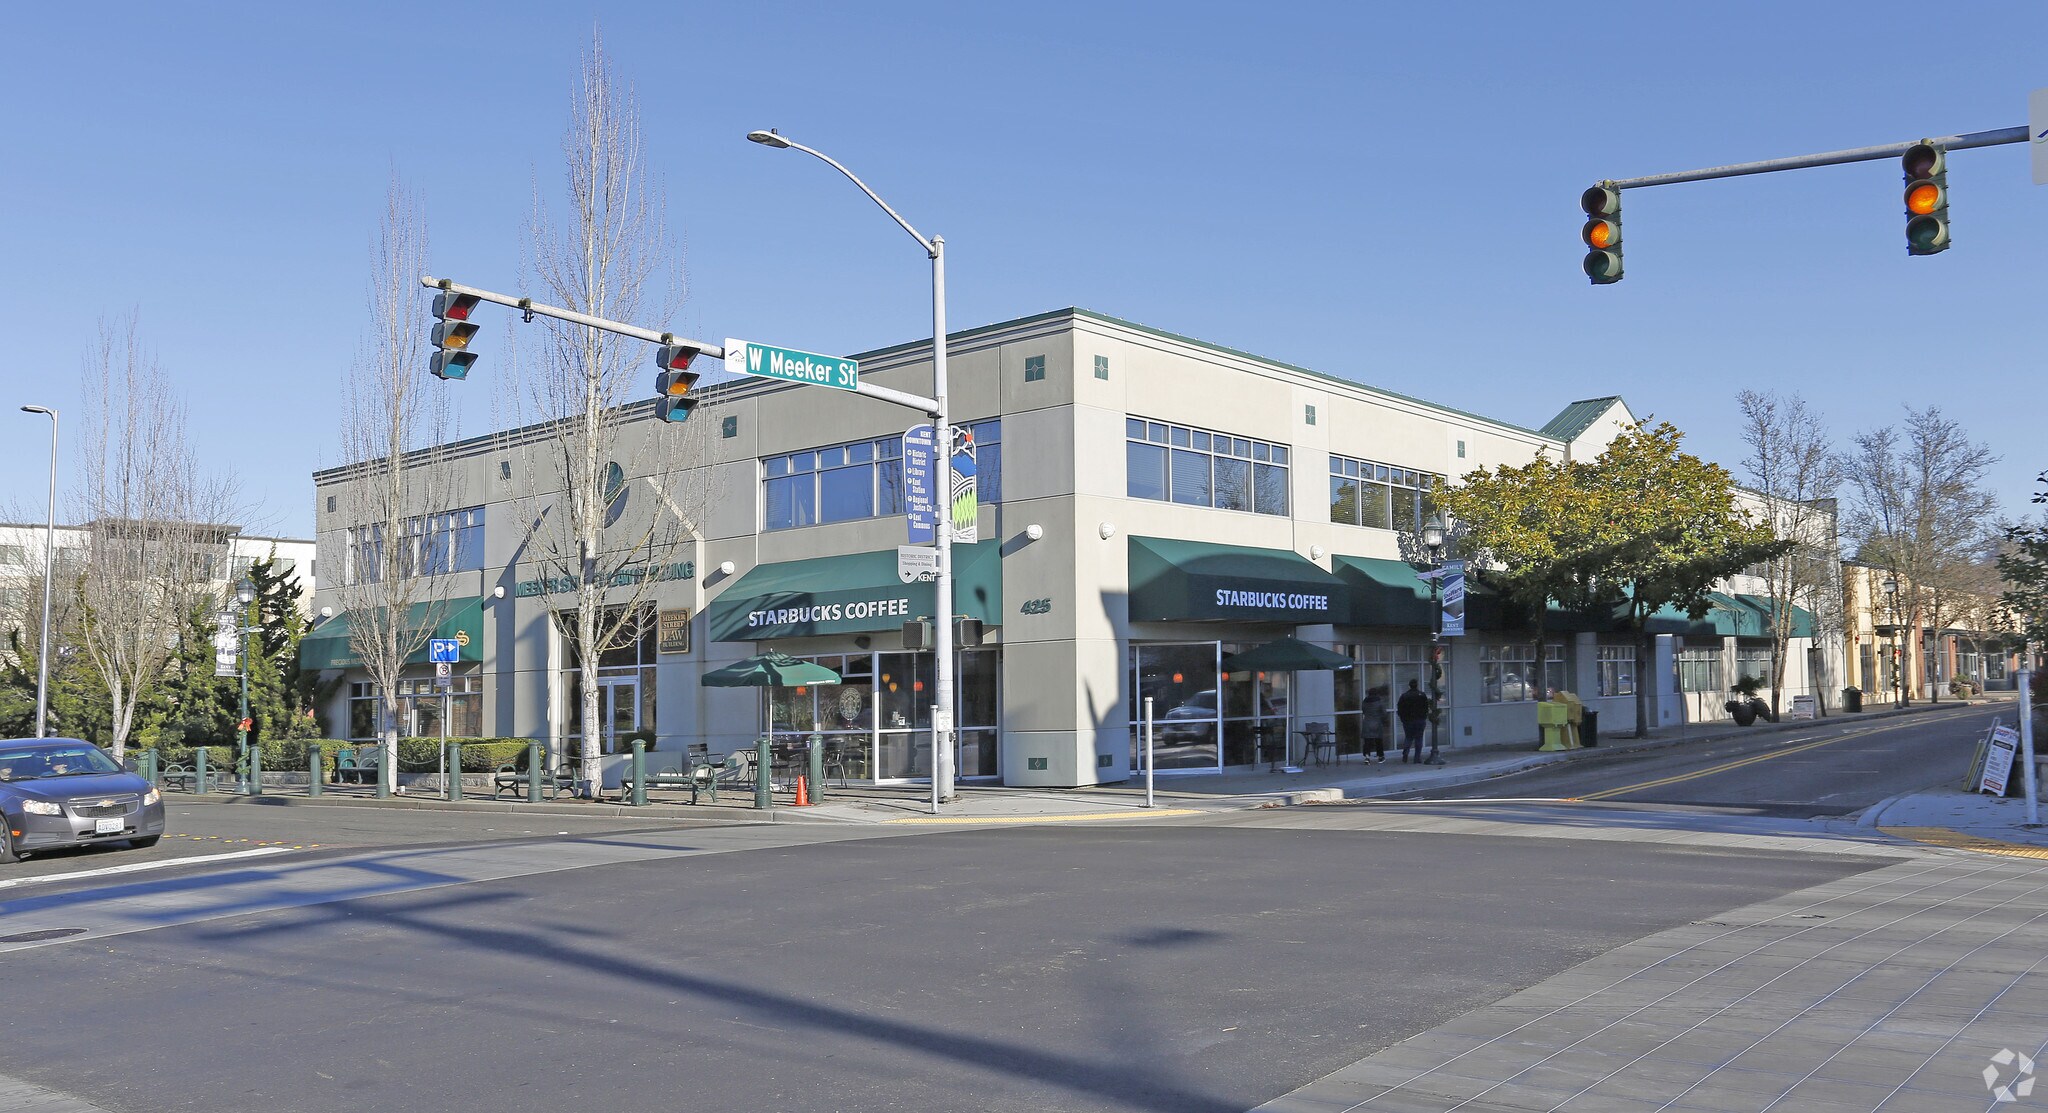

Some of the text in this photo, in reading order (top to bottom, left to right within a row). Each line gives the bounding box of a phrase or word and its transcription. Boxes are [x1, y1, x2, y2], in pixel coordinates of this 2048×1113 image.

[748, 346, 856, 387] W Meeker St
[906, 436, 932, 446] DOWNTOWN
[912, 449, 927, 458] Historic
[912, 458, 926, 466] District
[912, 467, 925, 477] Library
[912, 478, 921, 486] Kent
[912, 486, 926, 494] Station
[913, 495, 929, 505] Regional
[913, 504, 926, 512] Justice
[913, 513, 922, 521] Kent
[913, 521, 931, 530] Commons
[918, 573, 936, 582] KENT
[1216, 588, 1328, 611] STARBUCKS COFFEE
[1020, 598, 1052, 615] 425
[748, 598, 909, 627] STARBUCKS COFFEE
[663, 621, 685, 629] STREET
[662, 629, 685, 642] LAW
